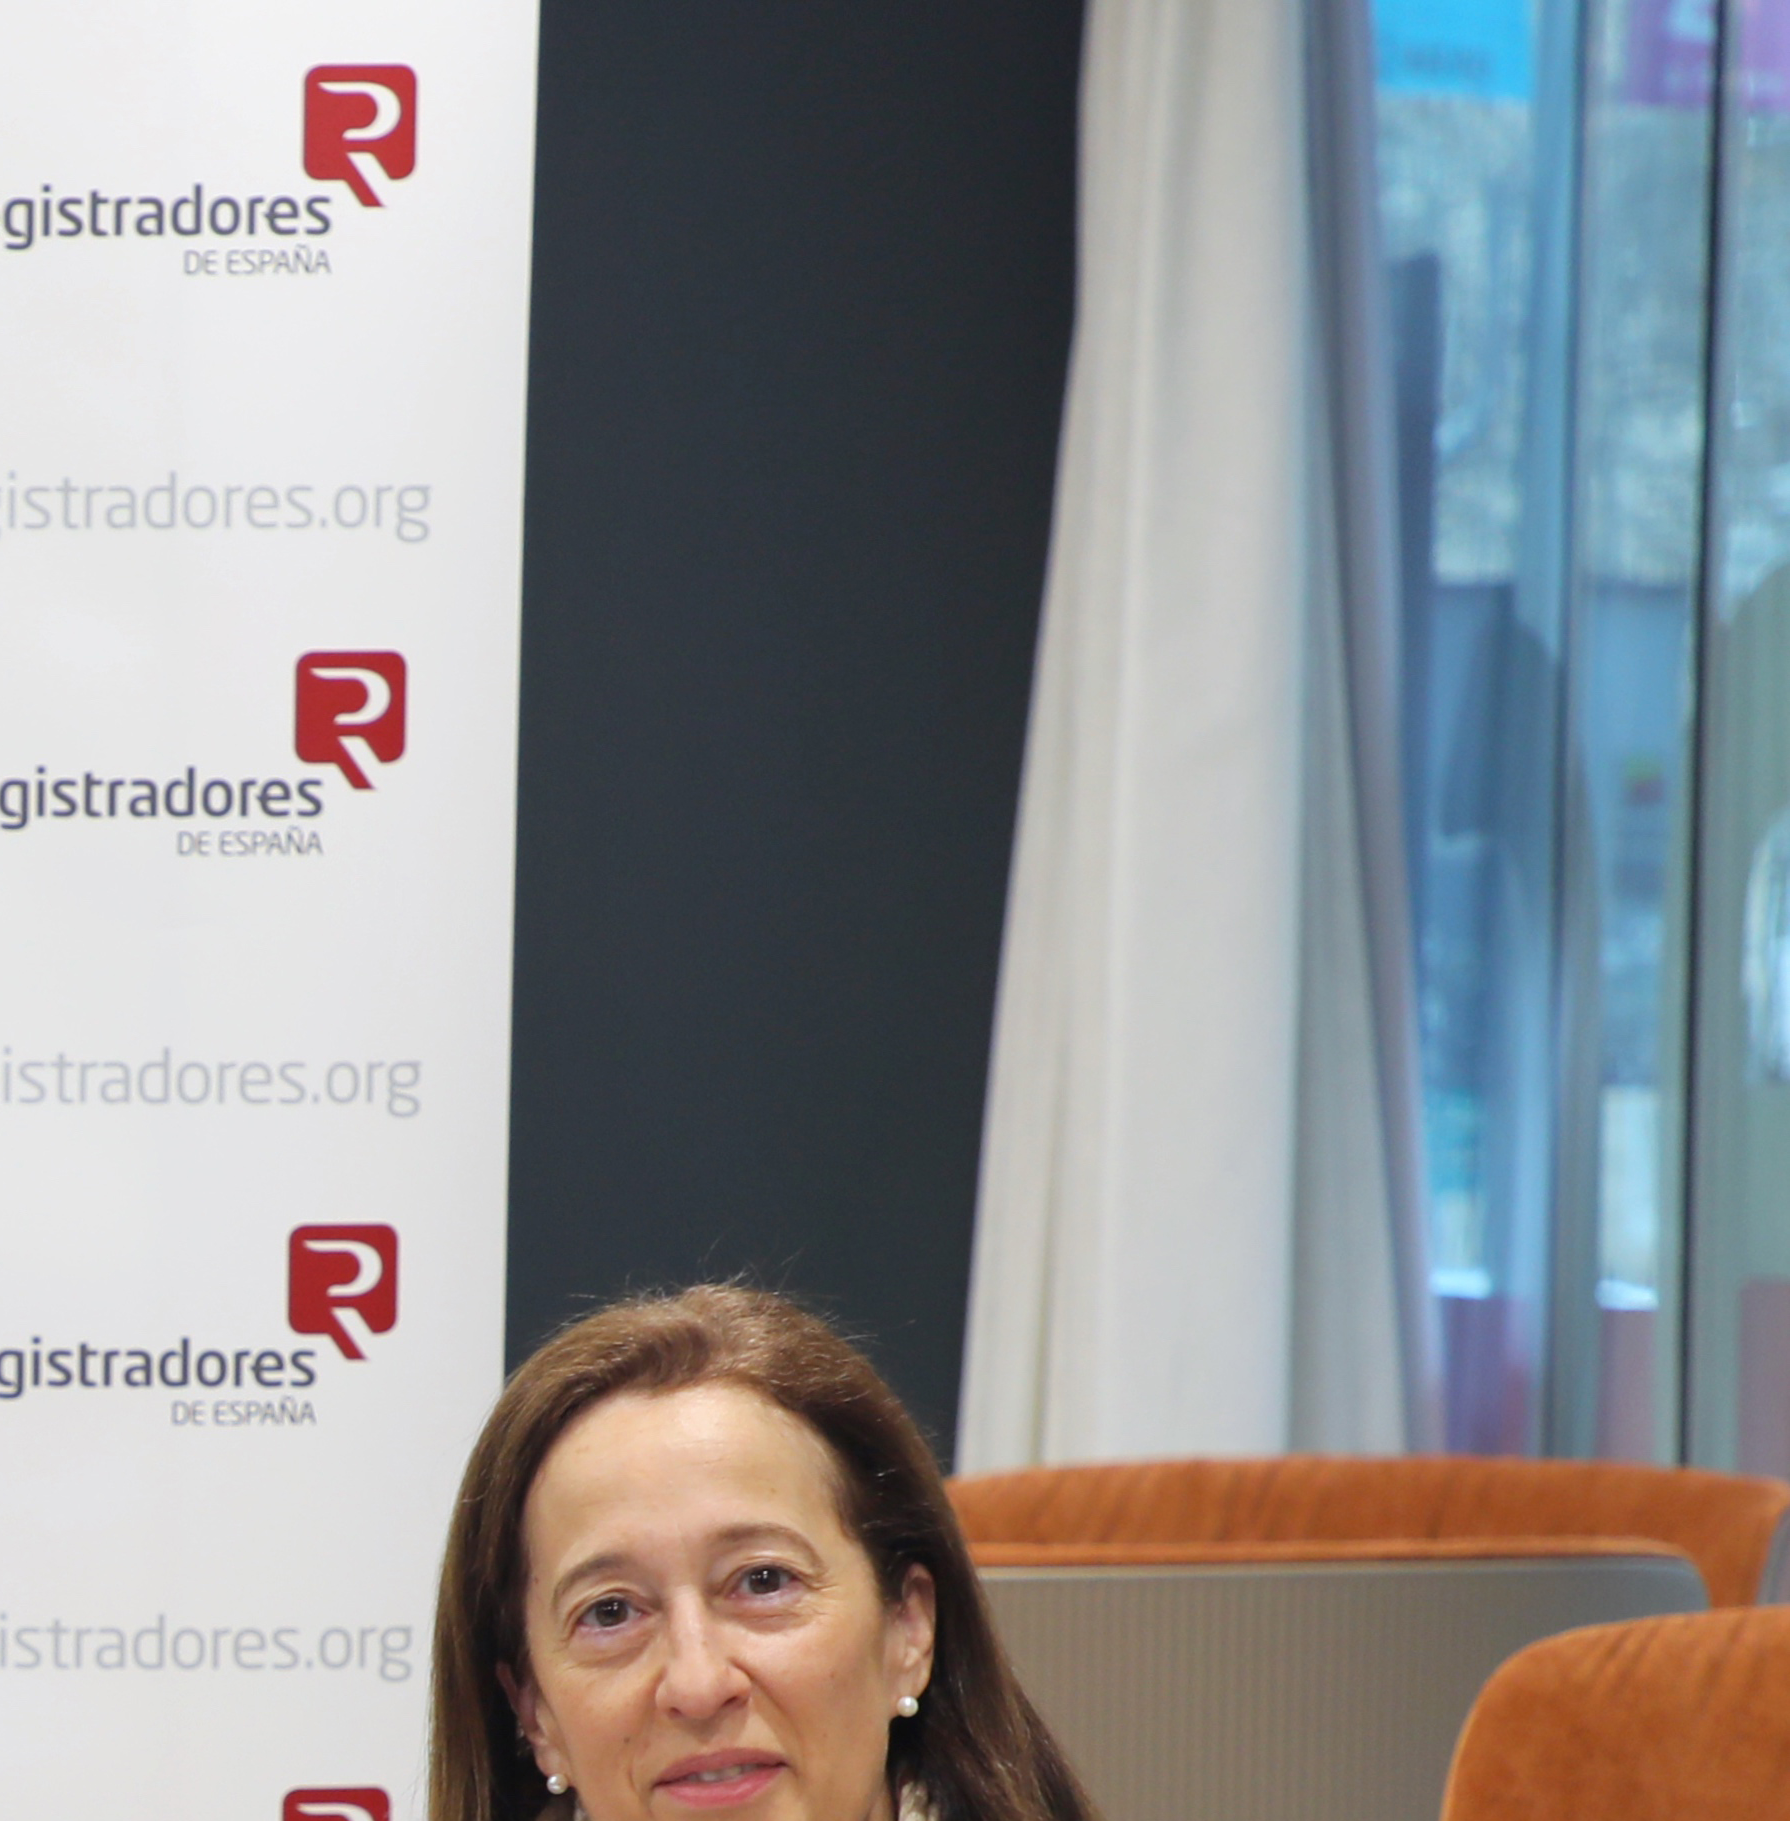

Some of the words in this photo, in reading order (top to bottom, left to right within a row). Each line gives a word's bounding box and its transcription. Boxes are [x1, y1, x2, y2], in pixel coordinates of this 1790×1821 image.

[183, 250, 217, 276] DE
[225, 244, 332, 276] ESPAÑA
[177, 831, 210, 857] DE
[218, 825, 324, 857] ESPAÑA
[171, 1400, 204, 1426] DE
[212, 1396, 317, 1427] ESPAÑA
